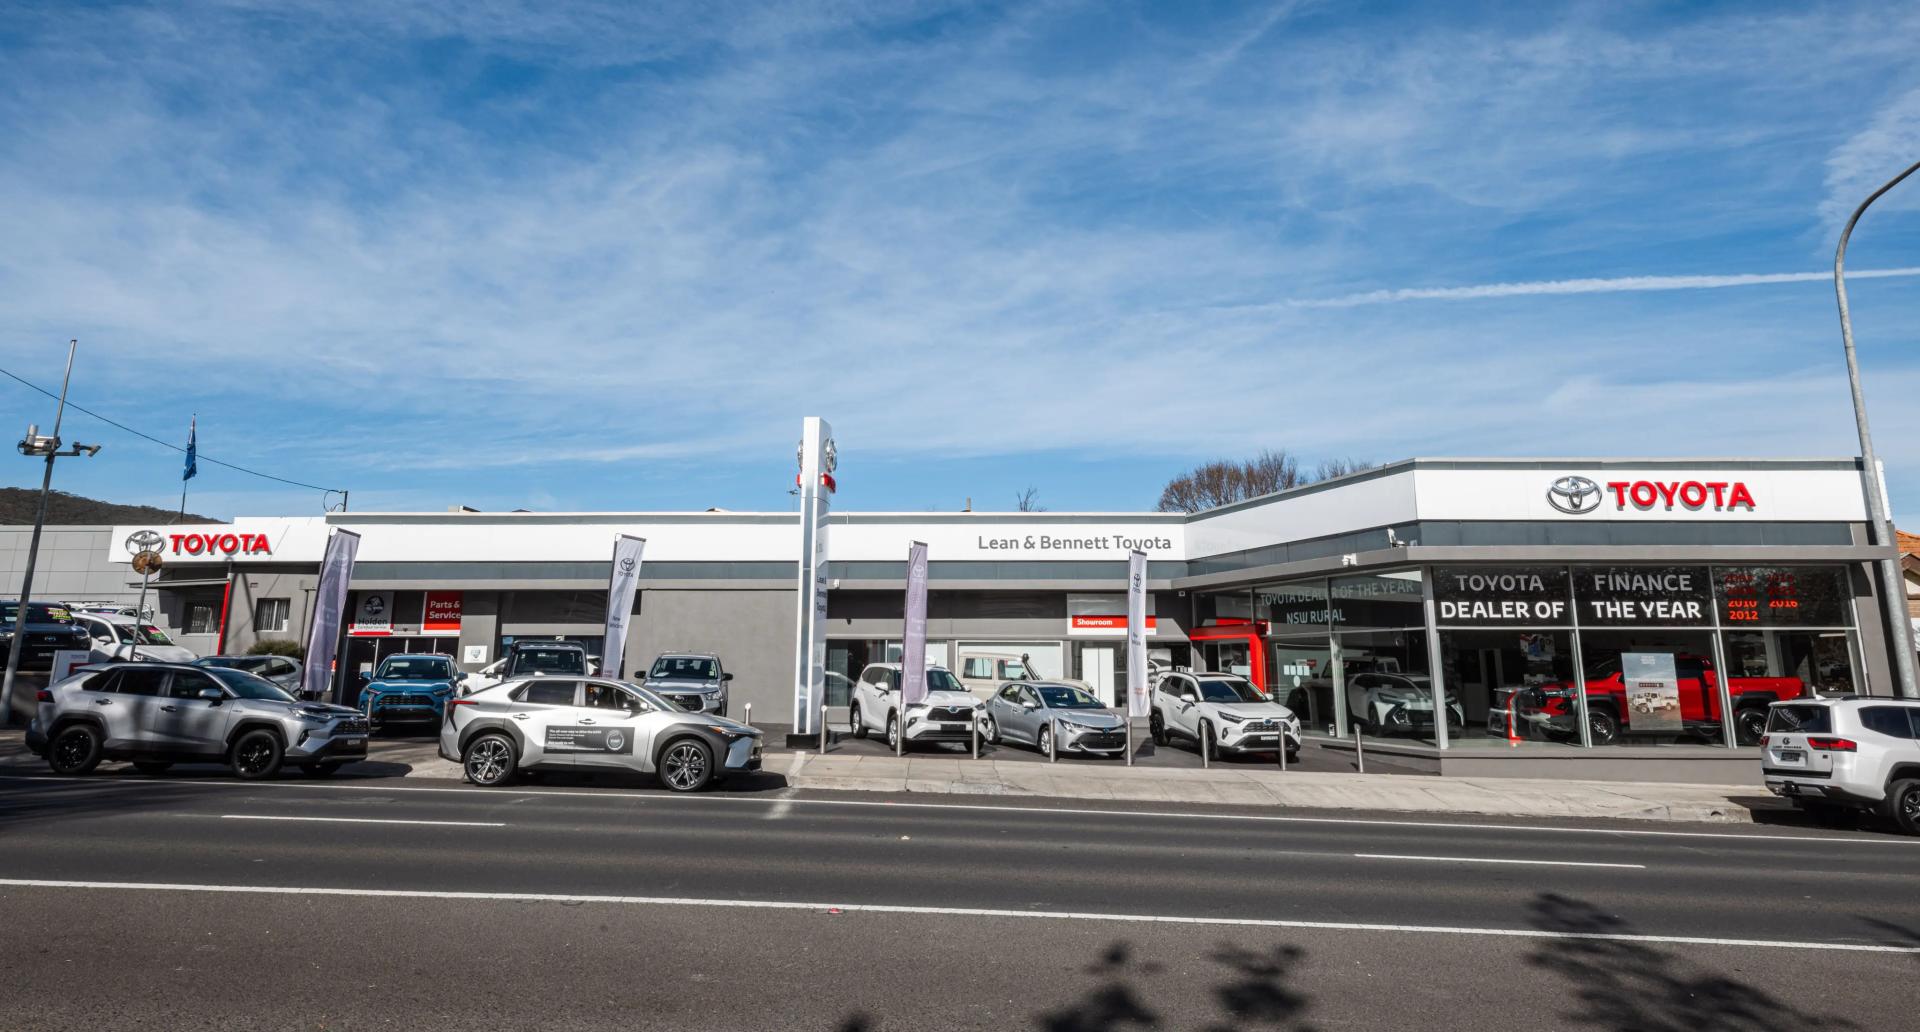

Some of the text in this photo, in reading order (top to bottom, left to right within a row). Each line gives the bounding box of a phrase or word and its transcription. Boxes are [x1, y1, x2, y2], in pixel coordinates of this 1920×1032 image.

[1606, 481, 1756, 511] TOYOTA
[169, 534, 272, 554] TOYOTA
[978, 535, 1171, 550] Lean & Bennett Toyota
[1455, 574, 1693, 591] TOYOTA FINANCE
[1260, 593, 1296, 606] TOYOTA
[1340, 584, 1354, 598] OF
[1357, 582, 1379, 598] THE
[1379, 580, 1415, 596] YEAR
[430, 601, 460, 609] Parts &
[1440, 601, 1702, 618] DEALER OF THE YEAR
[429, 611, 461, 619] Service
[1076, 618, 1113, 626] Showroom
[1286, 609, 1346, 625] NSW RURAL
[1729, 610, 1759, 620] 2012
